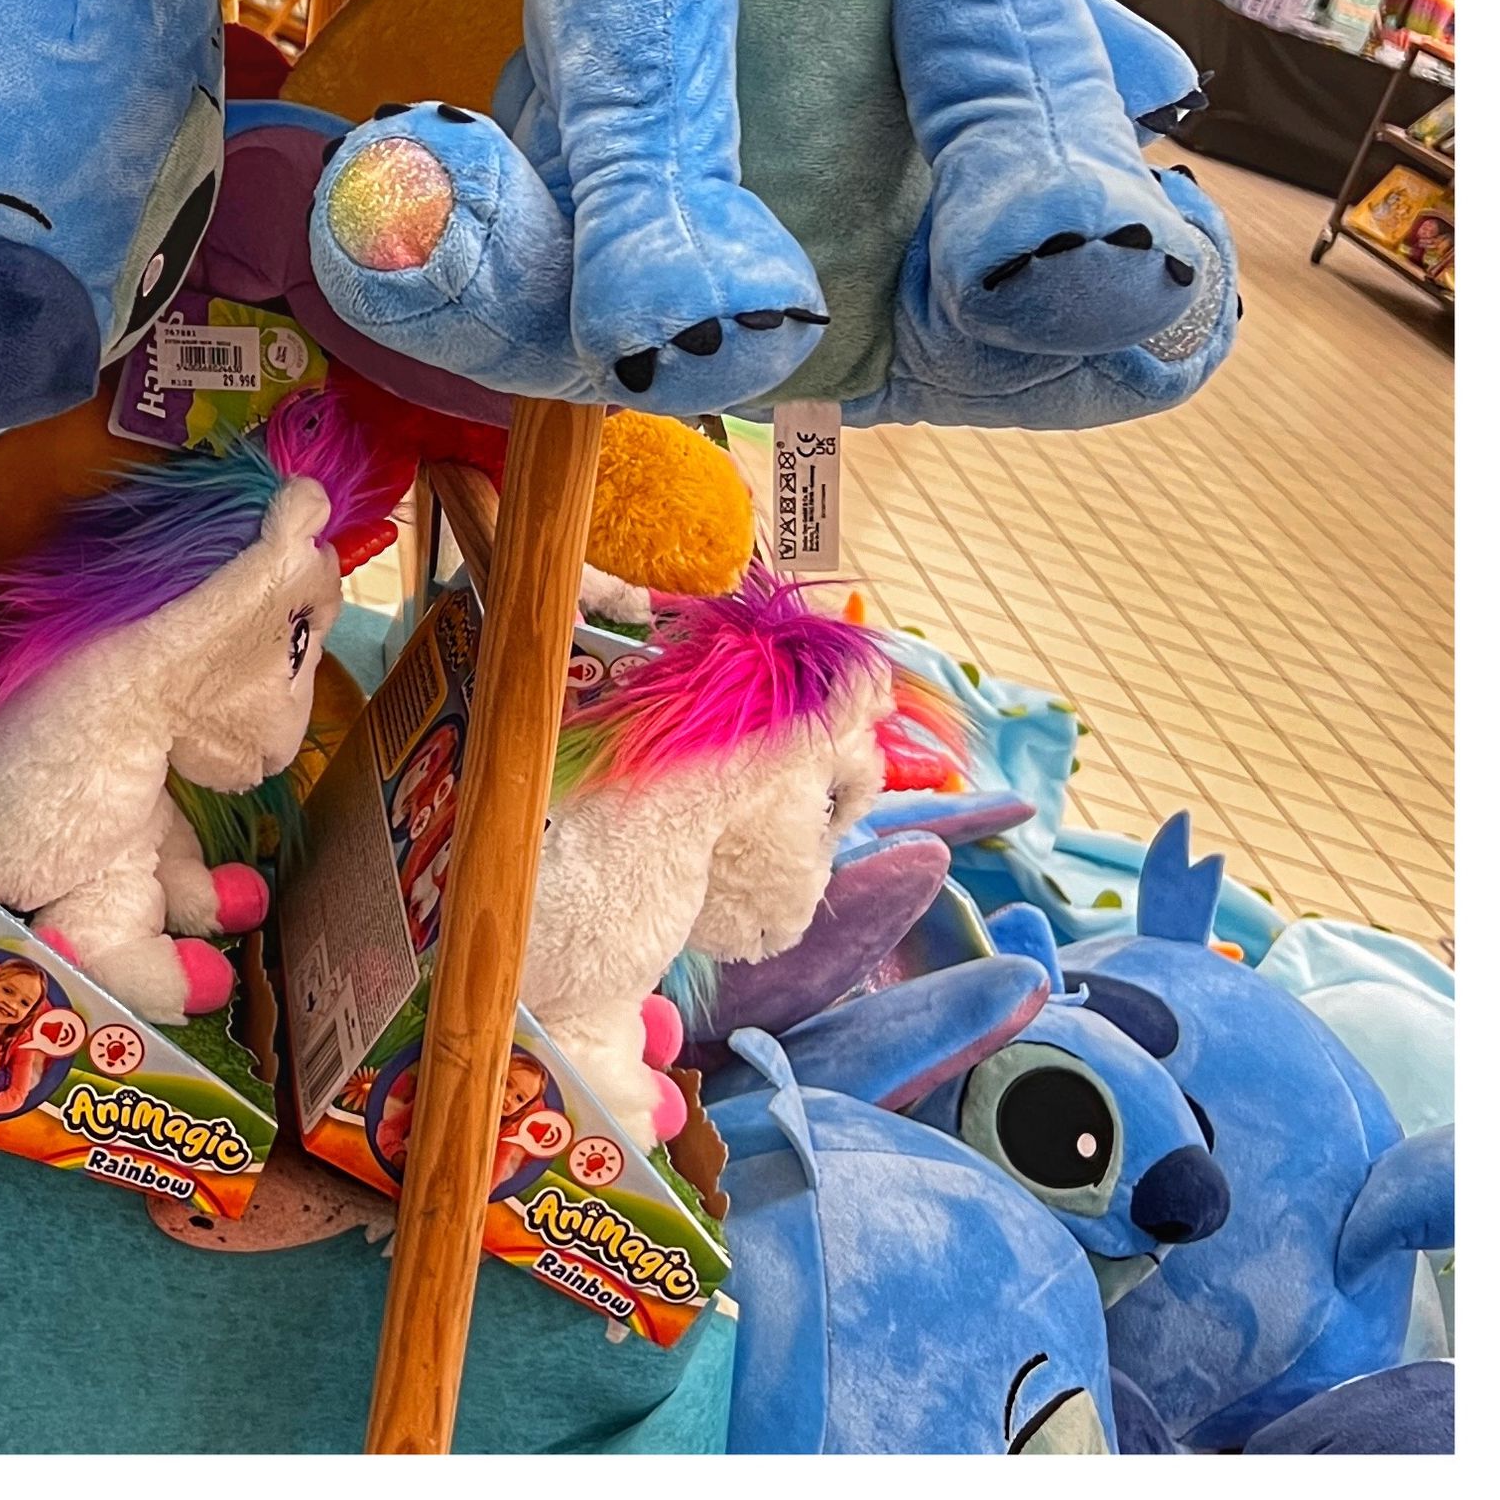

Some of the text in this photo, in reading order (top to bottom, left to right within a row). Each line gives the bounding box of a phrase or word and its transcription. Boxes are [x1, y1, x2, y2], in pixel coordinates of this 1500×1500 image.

[223, 373, 257, 388] 29.99€
[796, 431, 817, 458] CE
[816, 436, 825, 455] UK
[66, 1088, 246, 1166] AniMagic
[88, 1149, 192, 1197] Rainbow
[532, 1192, 693, 1296] AniMagic
[536, 1251, 632, 1315] Rainbow
